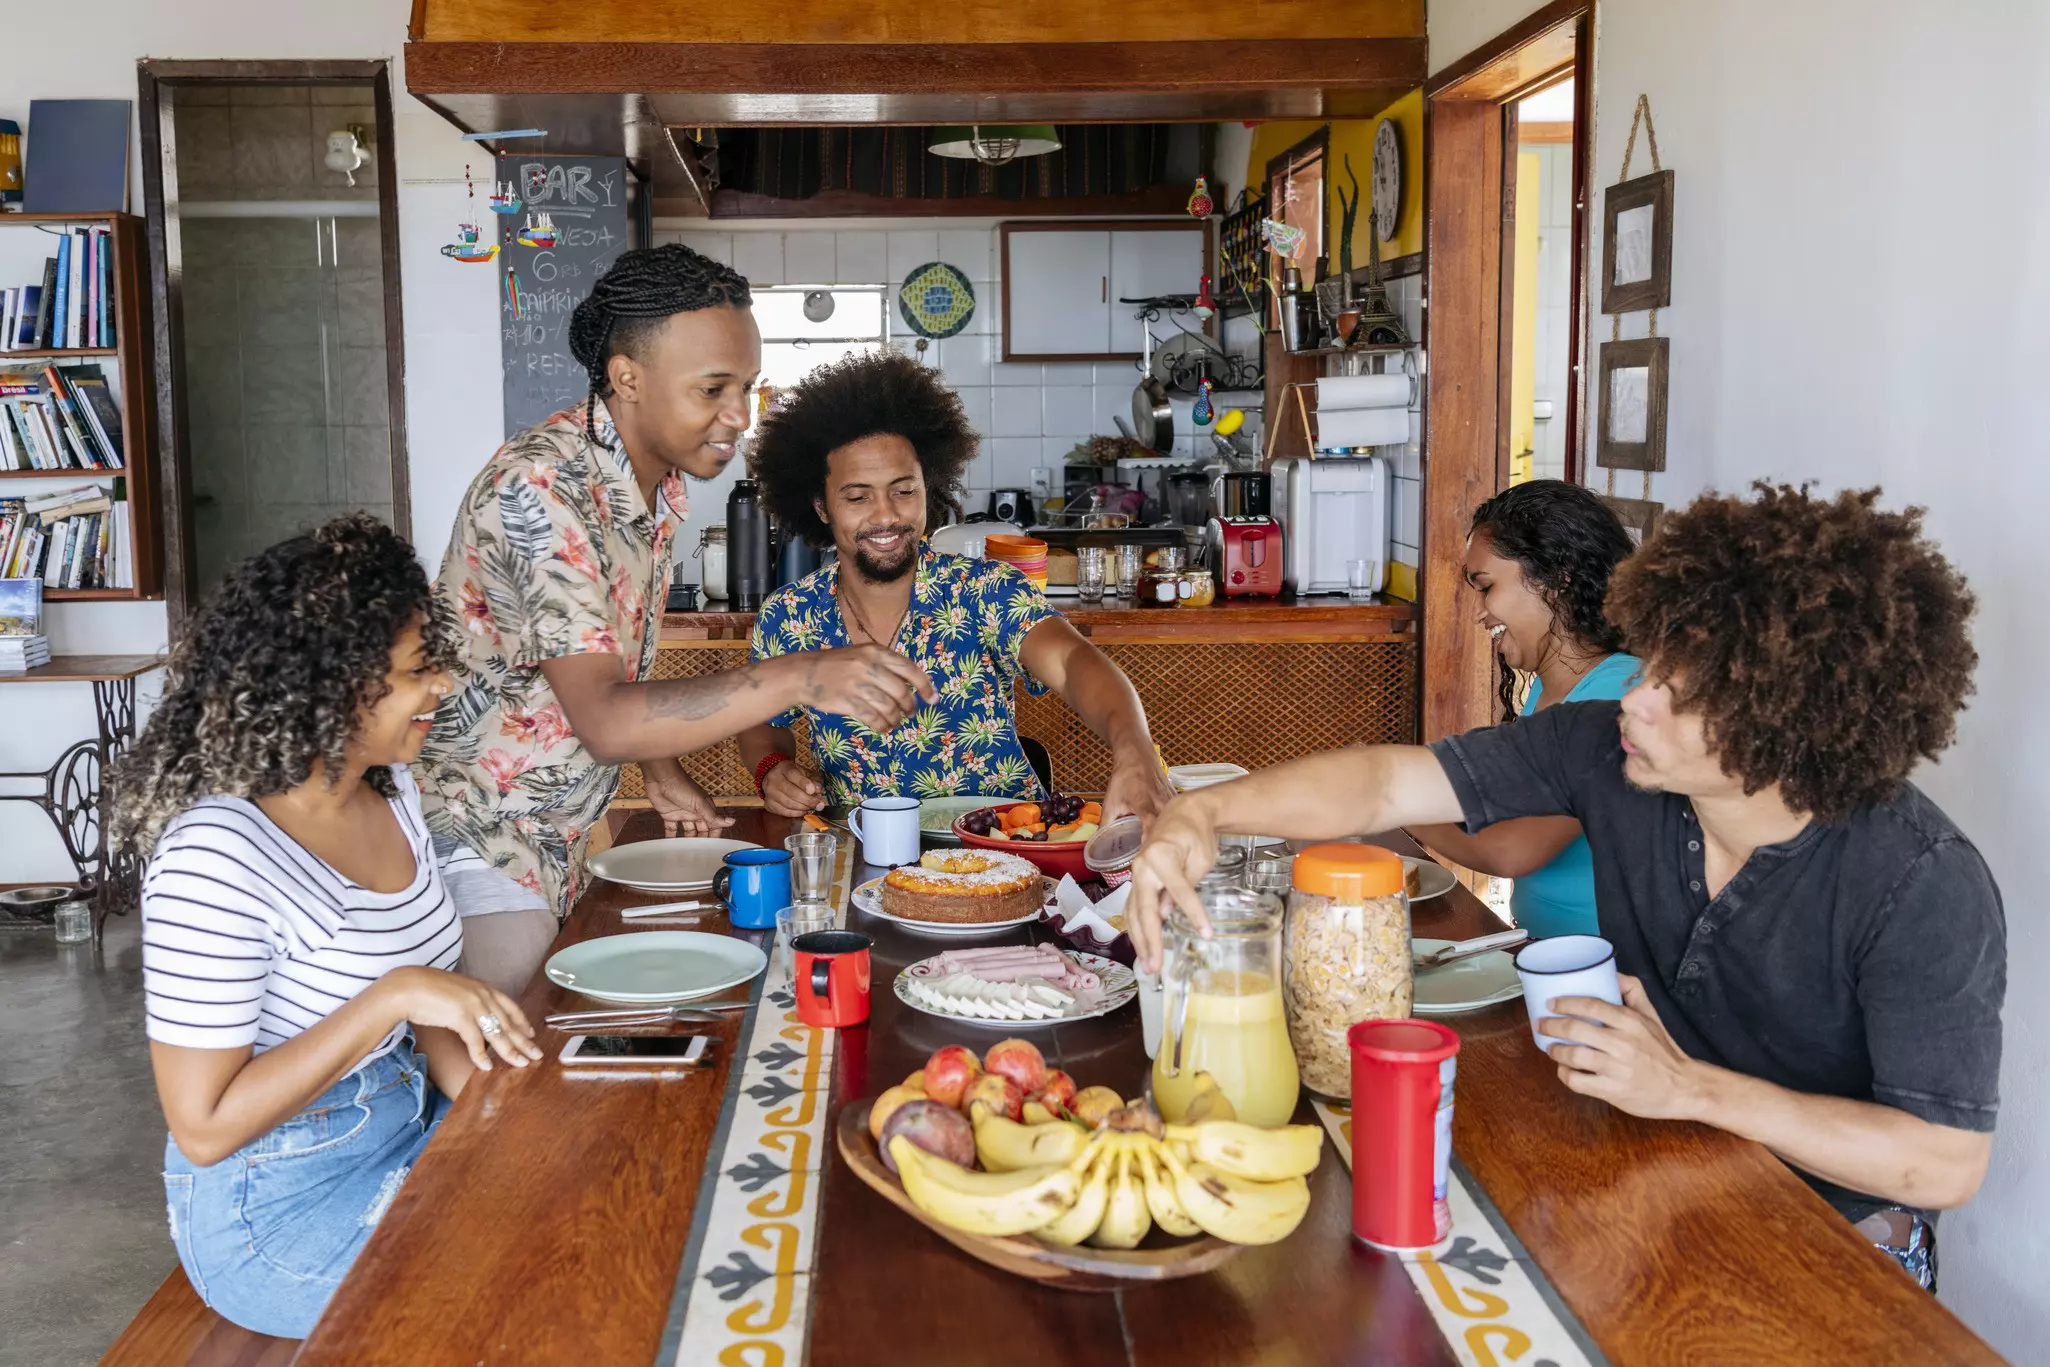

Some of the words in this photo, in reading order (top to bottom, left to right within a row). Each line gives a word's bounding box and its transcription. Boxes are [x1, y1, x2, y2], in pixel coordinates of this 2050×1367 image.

[520, 163, 599, 205] BAR
[532, 251, 558, 282] 6
[561, 262, 581, 279] R$
